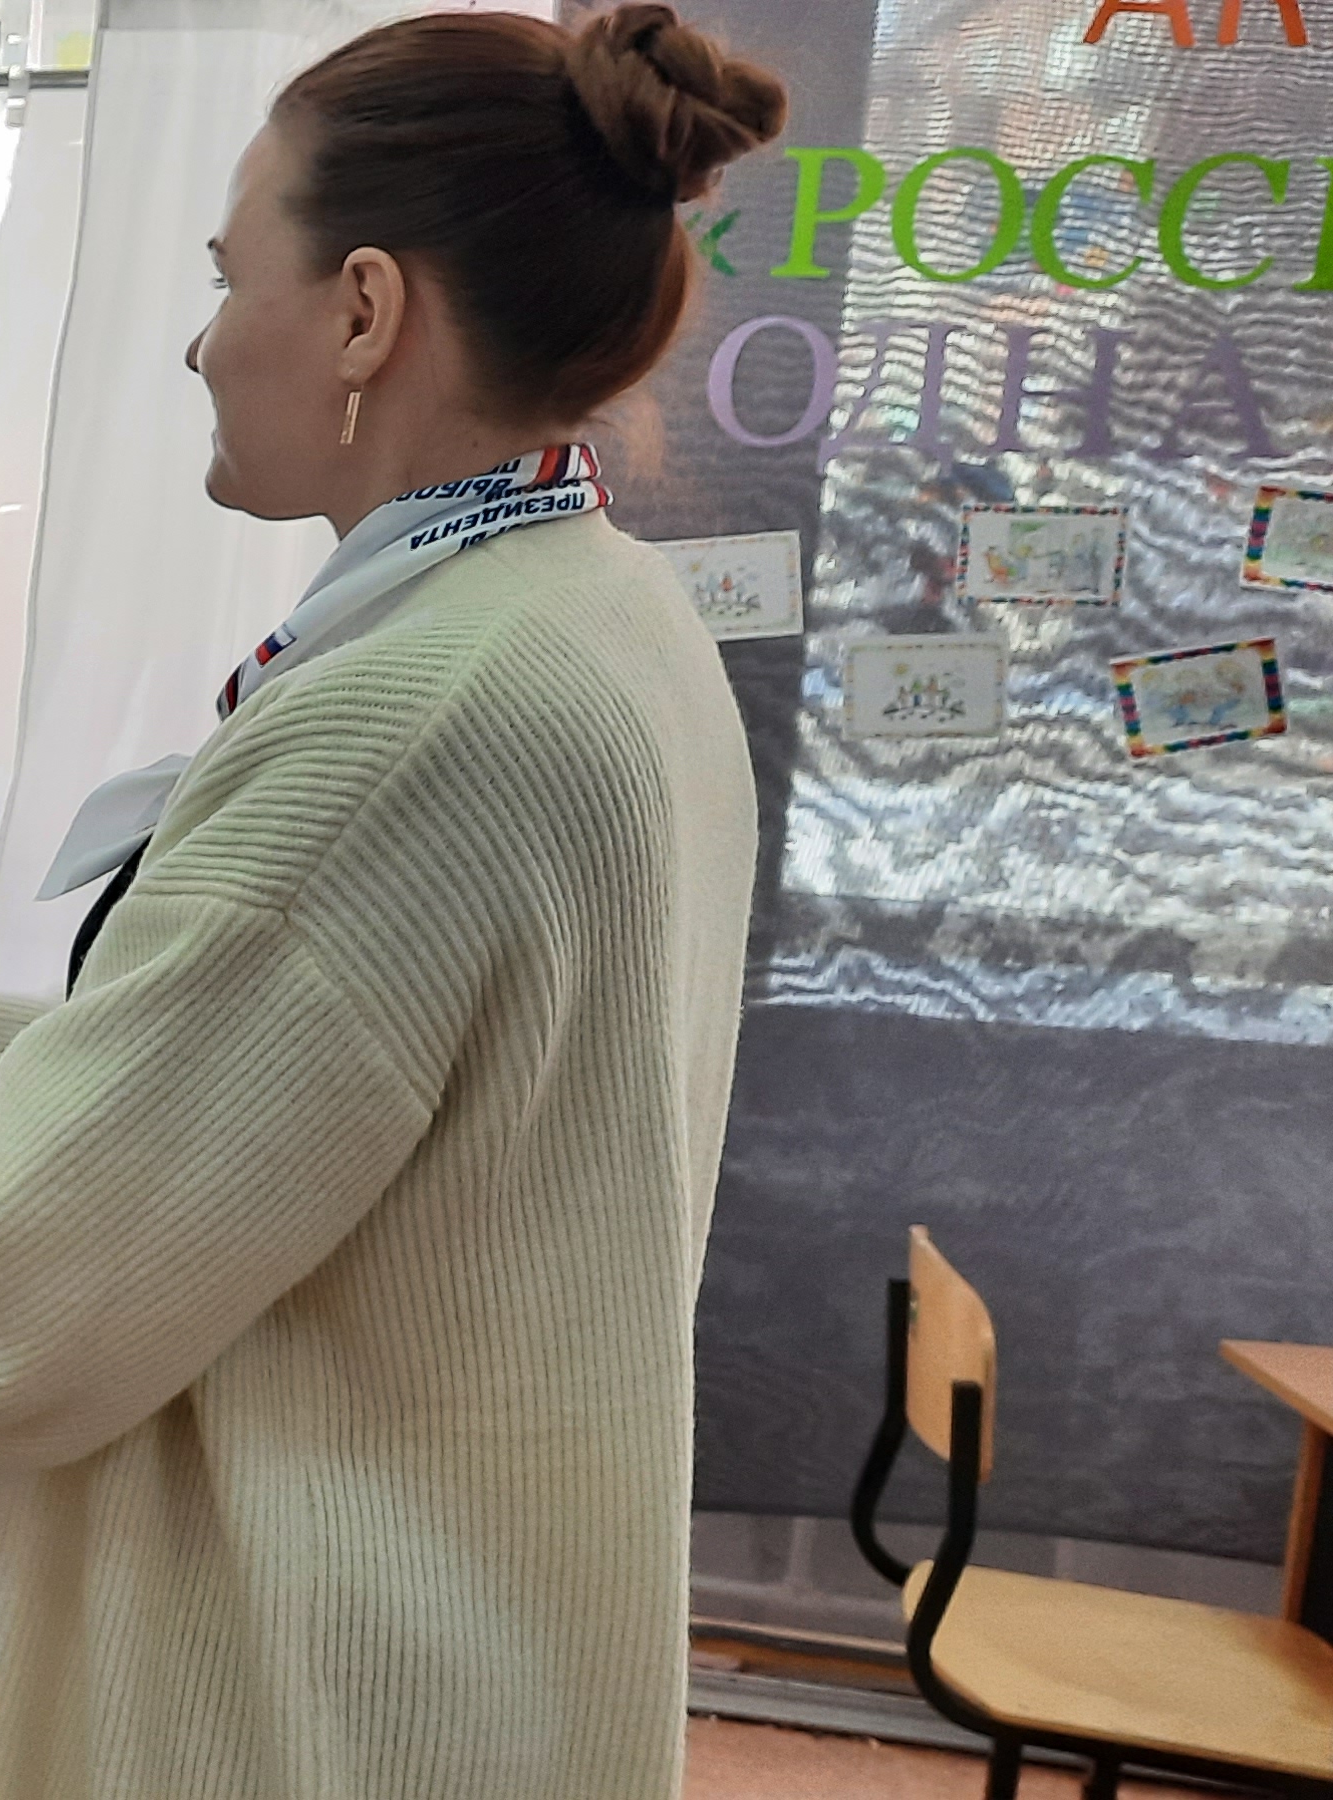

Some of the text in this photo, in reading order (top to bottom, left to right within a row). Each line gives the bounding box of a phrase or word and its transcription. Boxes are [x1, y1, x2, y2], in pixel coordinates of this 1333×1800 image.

[770, 146, 1333, 291] РОСС
[708, 314, 1295, 474] ОДНА
[410, 492, 587, 551] ПРЕЗИДЕНТА
